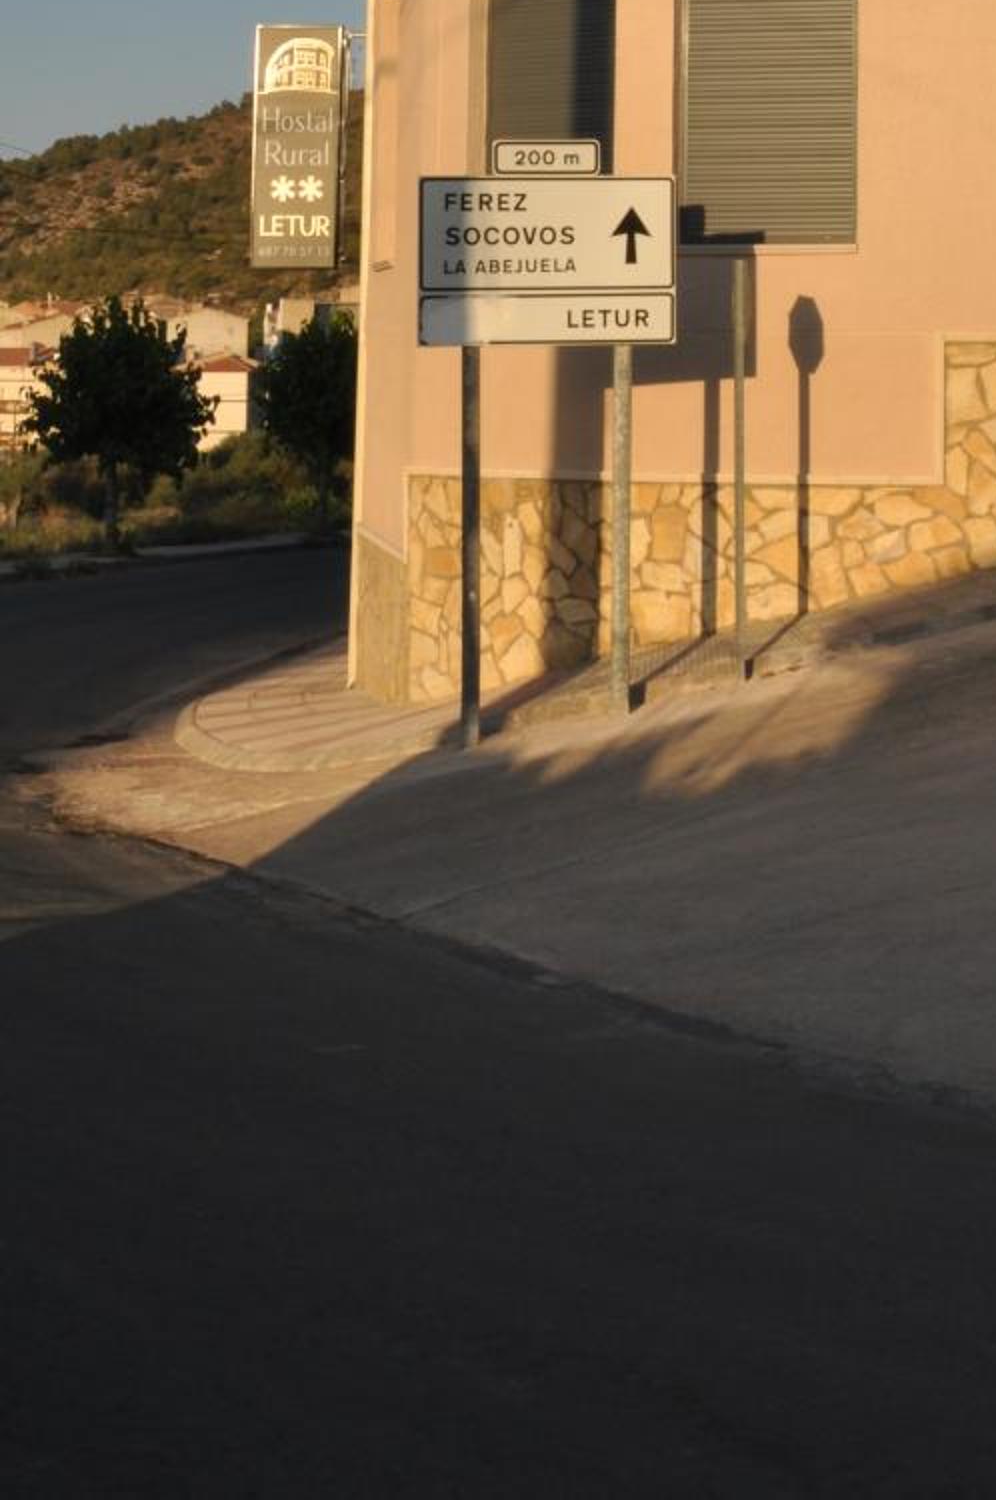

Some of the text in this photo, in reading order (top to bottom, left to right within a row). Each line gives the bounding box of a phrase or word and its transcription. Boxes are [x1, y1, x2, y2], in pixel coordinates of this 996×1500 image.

[262, 106, 334, 133] Hostal
[263, 139, 330, 165] Rural
[514, 150, 580, 166] 200 m
[444, 193, 528, 212] FEREZ
[259, 215, 330, 237] LETUR
[445, 226, 576, 246] SOCOVOS
[443, 257, 577, 275] LA ABEJUELA
[566, 309, 649, 329] LETUR
